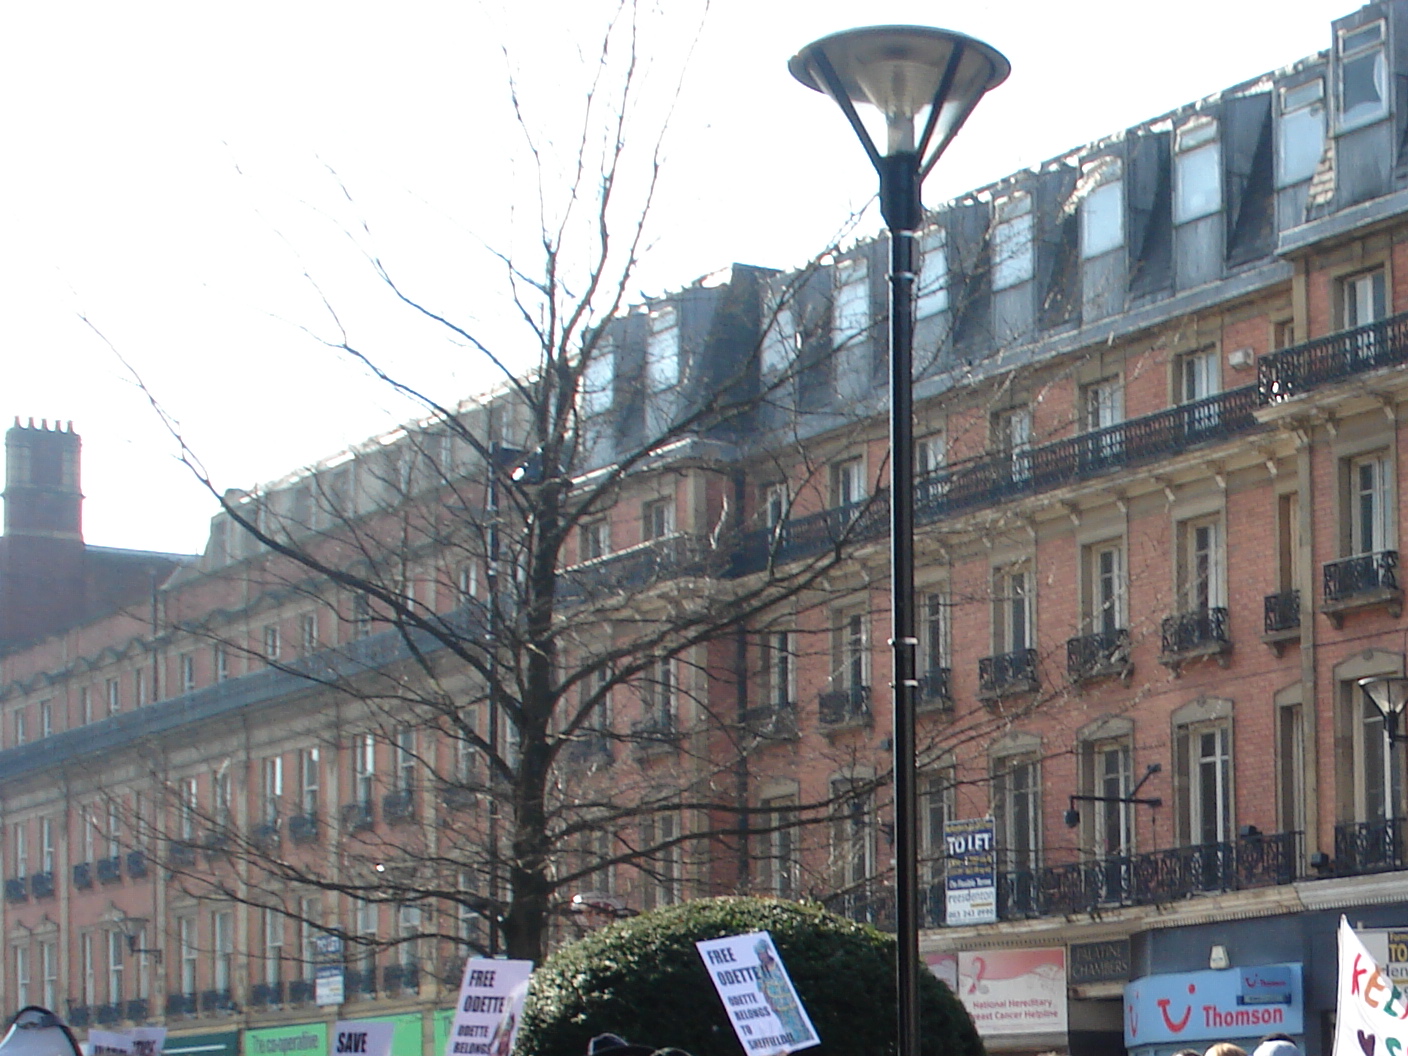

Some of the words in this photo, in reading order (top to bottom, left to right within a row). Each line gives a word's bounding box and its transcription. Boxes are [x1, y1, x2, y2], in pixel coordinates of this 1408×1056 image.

[947, 835, 966, 856] TO
[968, 832, 991, 852] LET
[706, 946, 737, 966] FREE
[1389, 942, 1408, 962] TO
[469, 969, 497, 988] FREE
[463, 995, 505, 1014] ODETTE
[973, 1000, 1007, 1009] National
[1008, 998, 1053, 1009] Hereditary
[733, 1005, 771, 1022] BELONGS
[995, 1010, 1022, 1019] Cancer
[1024, 1009, 1058, 1019] Helpline
[1202, 1004, 1284, 1028] Thomson
[457, 1024, 490, 1038] ODETTE
[740, 1024, 753, 1037] TO
[336, 1032, 368, 1054] SAVE
[452, 1041, 492, 1055] BELONGS
